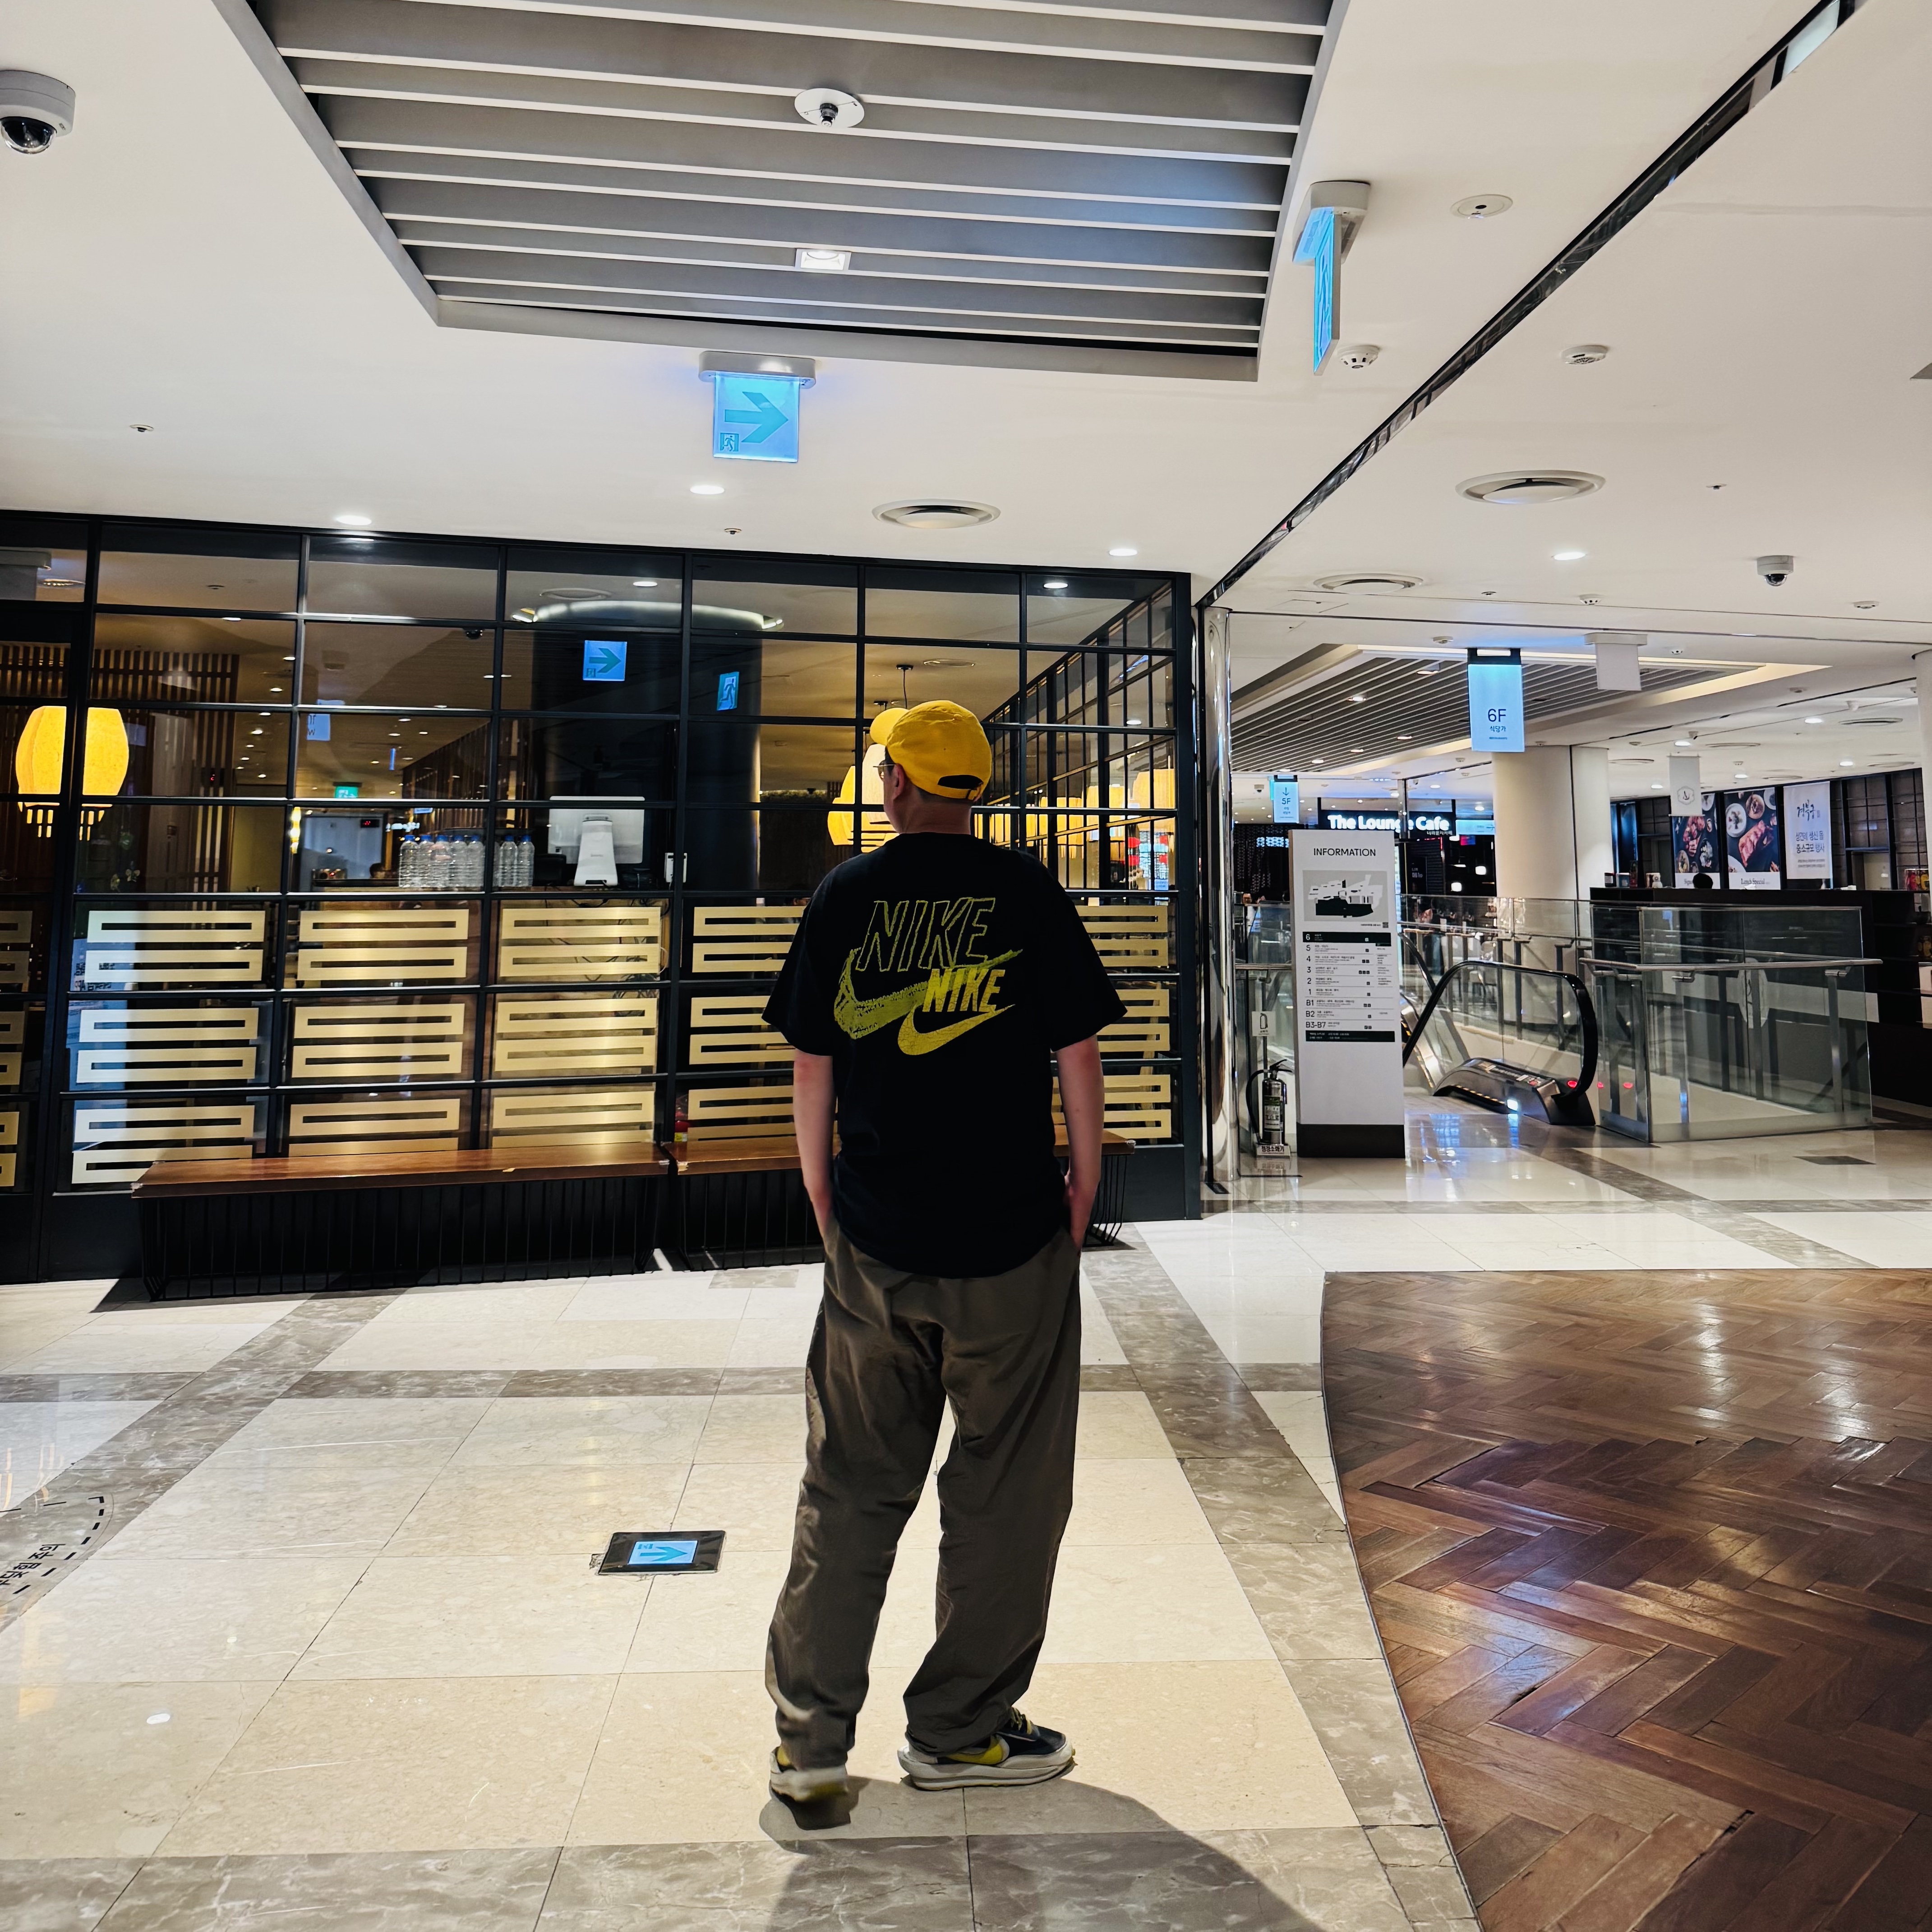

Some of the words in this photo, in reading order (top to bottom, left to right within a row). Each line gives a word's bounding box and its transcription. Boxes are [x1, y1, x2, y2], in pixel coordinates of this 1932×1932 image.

[1488, 708, 1506, 722] 6F
[1328, 814, 1356, 829] The
[1416, 816, 1449, 831] Cafe
[1314, 848, 1376, 856] INFORMATION
[855, 897, 996, 972] NIKE
[922, 968, 1005, 1012] NIKE
[28, 1543, 66, 1559] 주의
